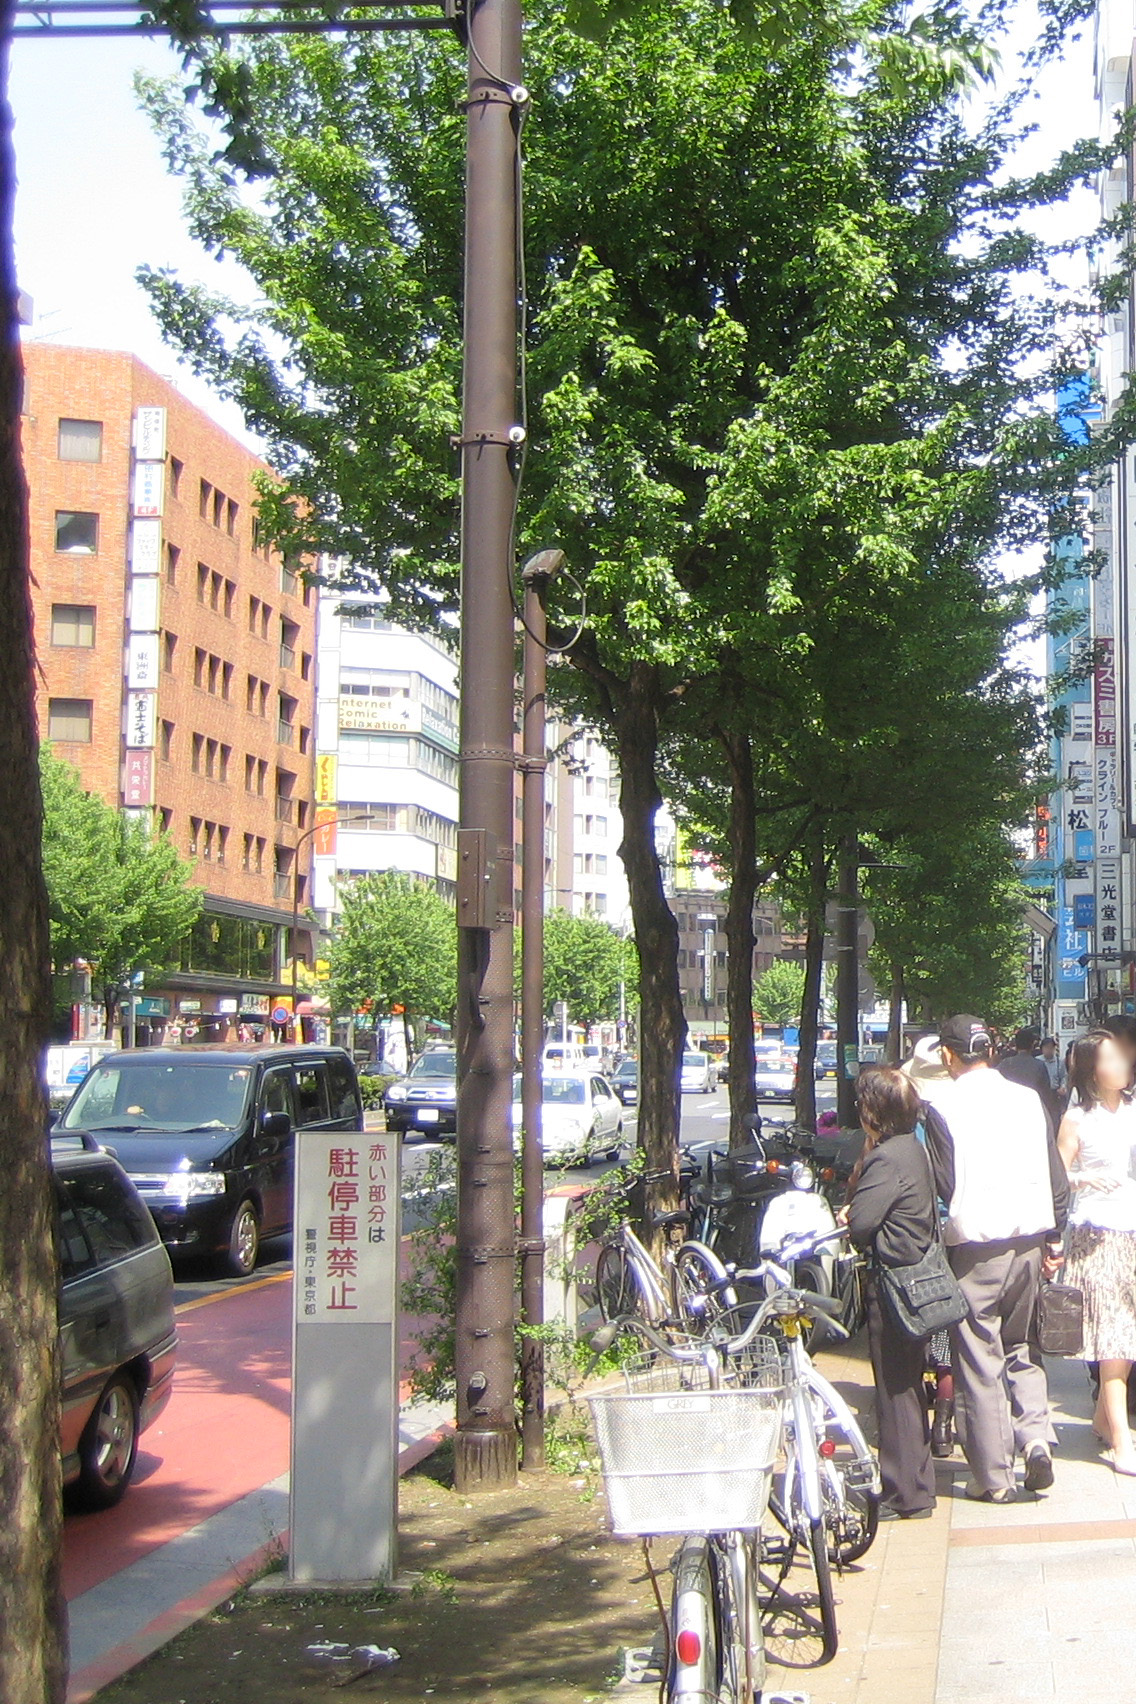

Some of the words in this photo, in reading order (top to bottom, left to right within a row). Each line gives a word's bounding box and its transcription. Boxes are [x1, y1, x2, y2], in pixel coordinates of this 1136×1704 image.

[338, 718, 407, 730] Relaxation
[339, 708, 378, 718] Comic
[340, 698, 392, 709] nternet
[1100, 845, 1116, 854] 2F
[1101, 863, 1117, 963] 三光堂書店
[368, 1143, 387, 1244] 赤い部分は
[326, 1147, 360, 1310] 駐停車禁止
[304, 1228, 318, 1316] 警視庁・東京都
